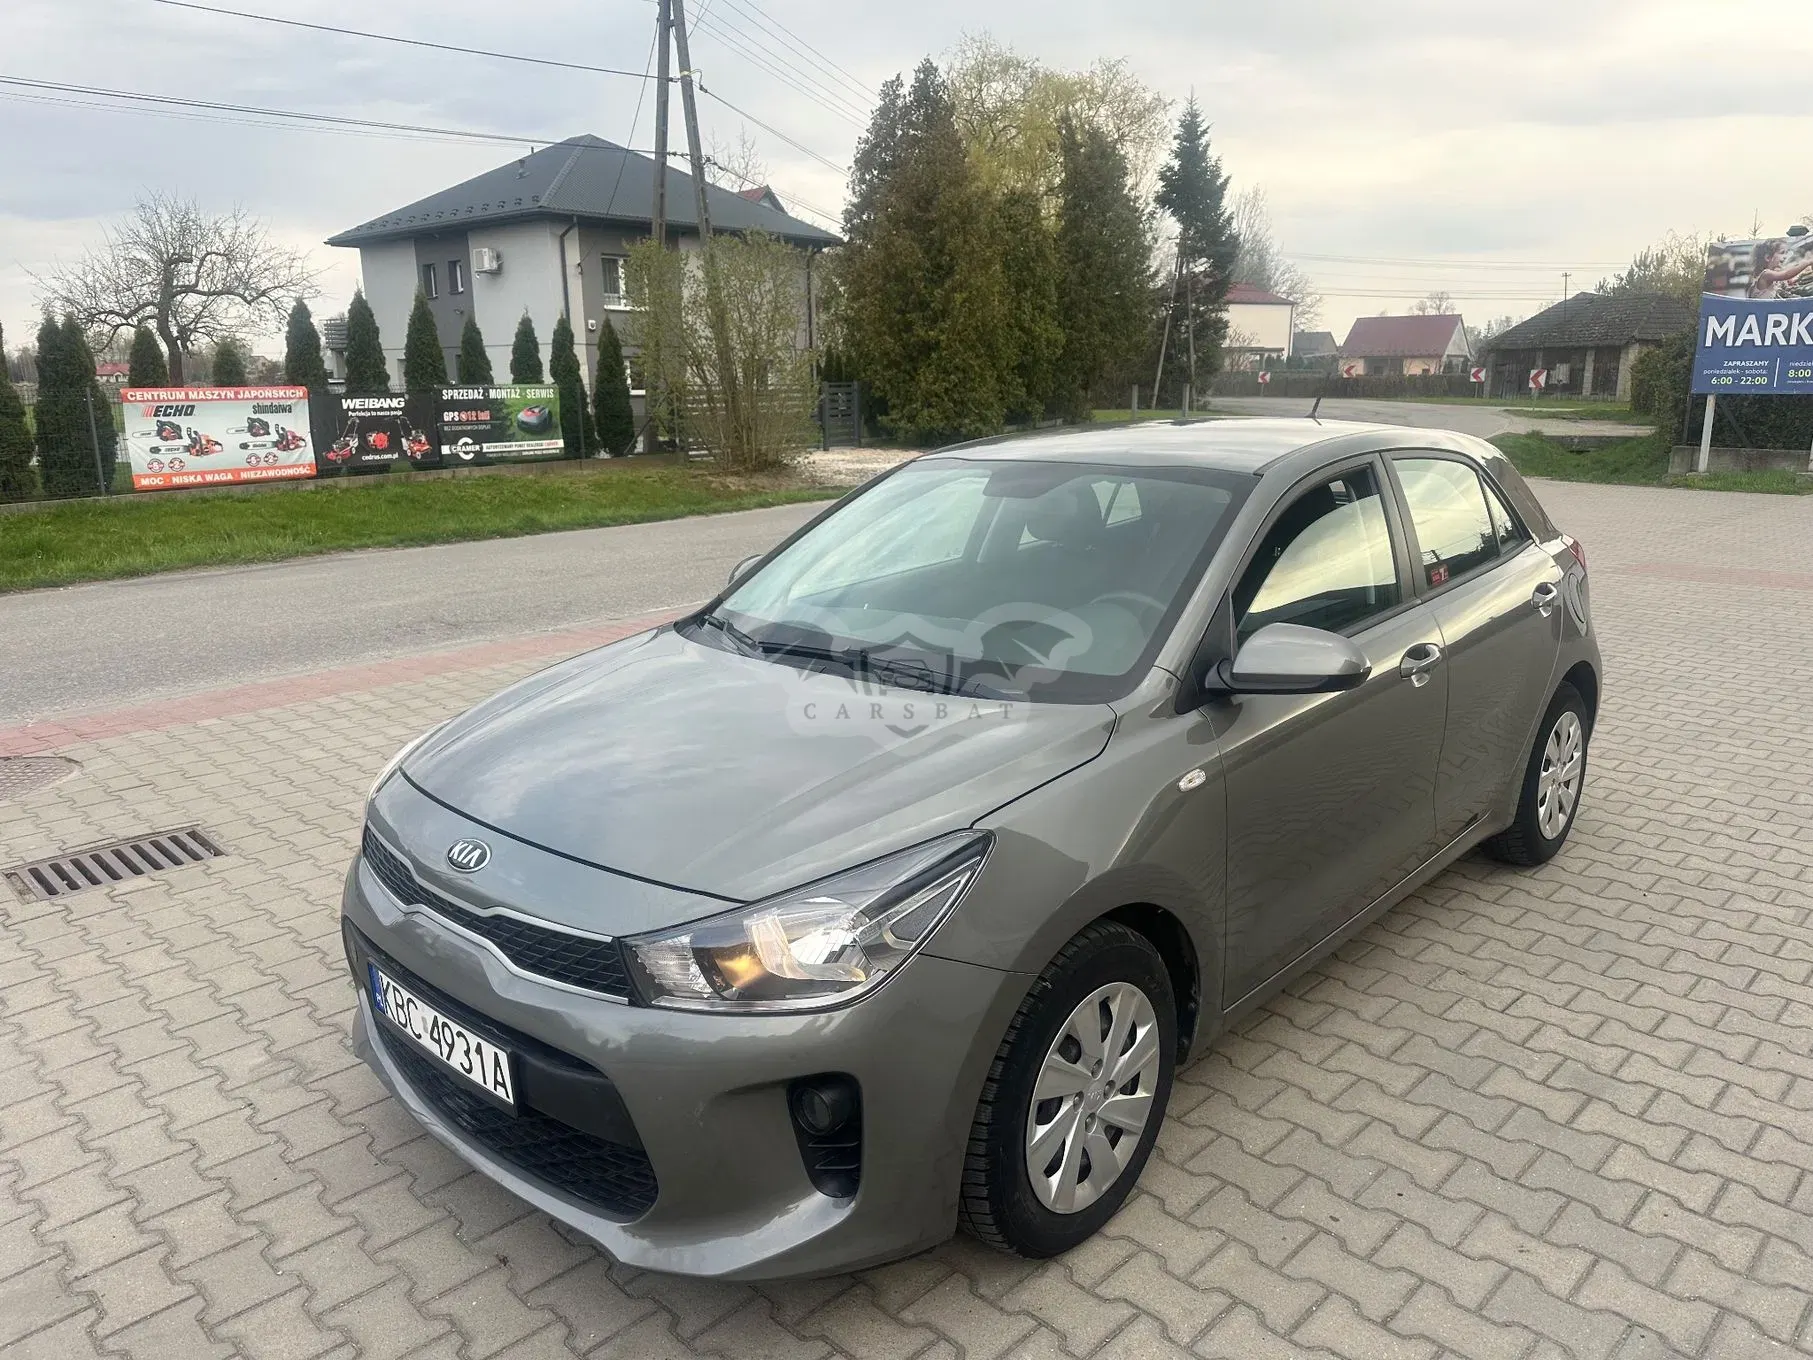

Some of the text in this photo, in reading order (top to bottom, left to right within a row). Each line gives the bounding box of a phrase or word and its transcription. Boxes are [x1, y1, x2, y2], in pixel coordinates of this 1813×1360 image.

[1704, 312, 1813, 347] MARK
[1788, 369, 1811, 378] 8:00
[1711, 376, 1733, 385] 6:00
[1740, 376, 1768, 385] 22:00
[127, 388, 304, 401] CENTRUM MASZYN JAPOŃSKICH
[442, 387, 554, 400] SPRZEDAŻ MONTAŻ SERWIS
[252, 402, 293, 415] shindaiwa
[341, 397, 405, 410] WEIBANG
[152, 404, 195, 417] ECHO
[443, 411, 460, 421] GPS
[451, 444, 480, 452] CRAMER
[361, 452, 399, 461] cedrus.com.pl
[140, 466, 311, 486] MOC NISKA WAGA NIEZAWODNOŚĆ
[448, 840, 480, 868] KIA
[380, 975, 511, 1100] KBC 4931A
